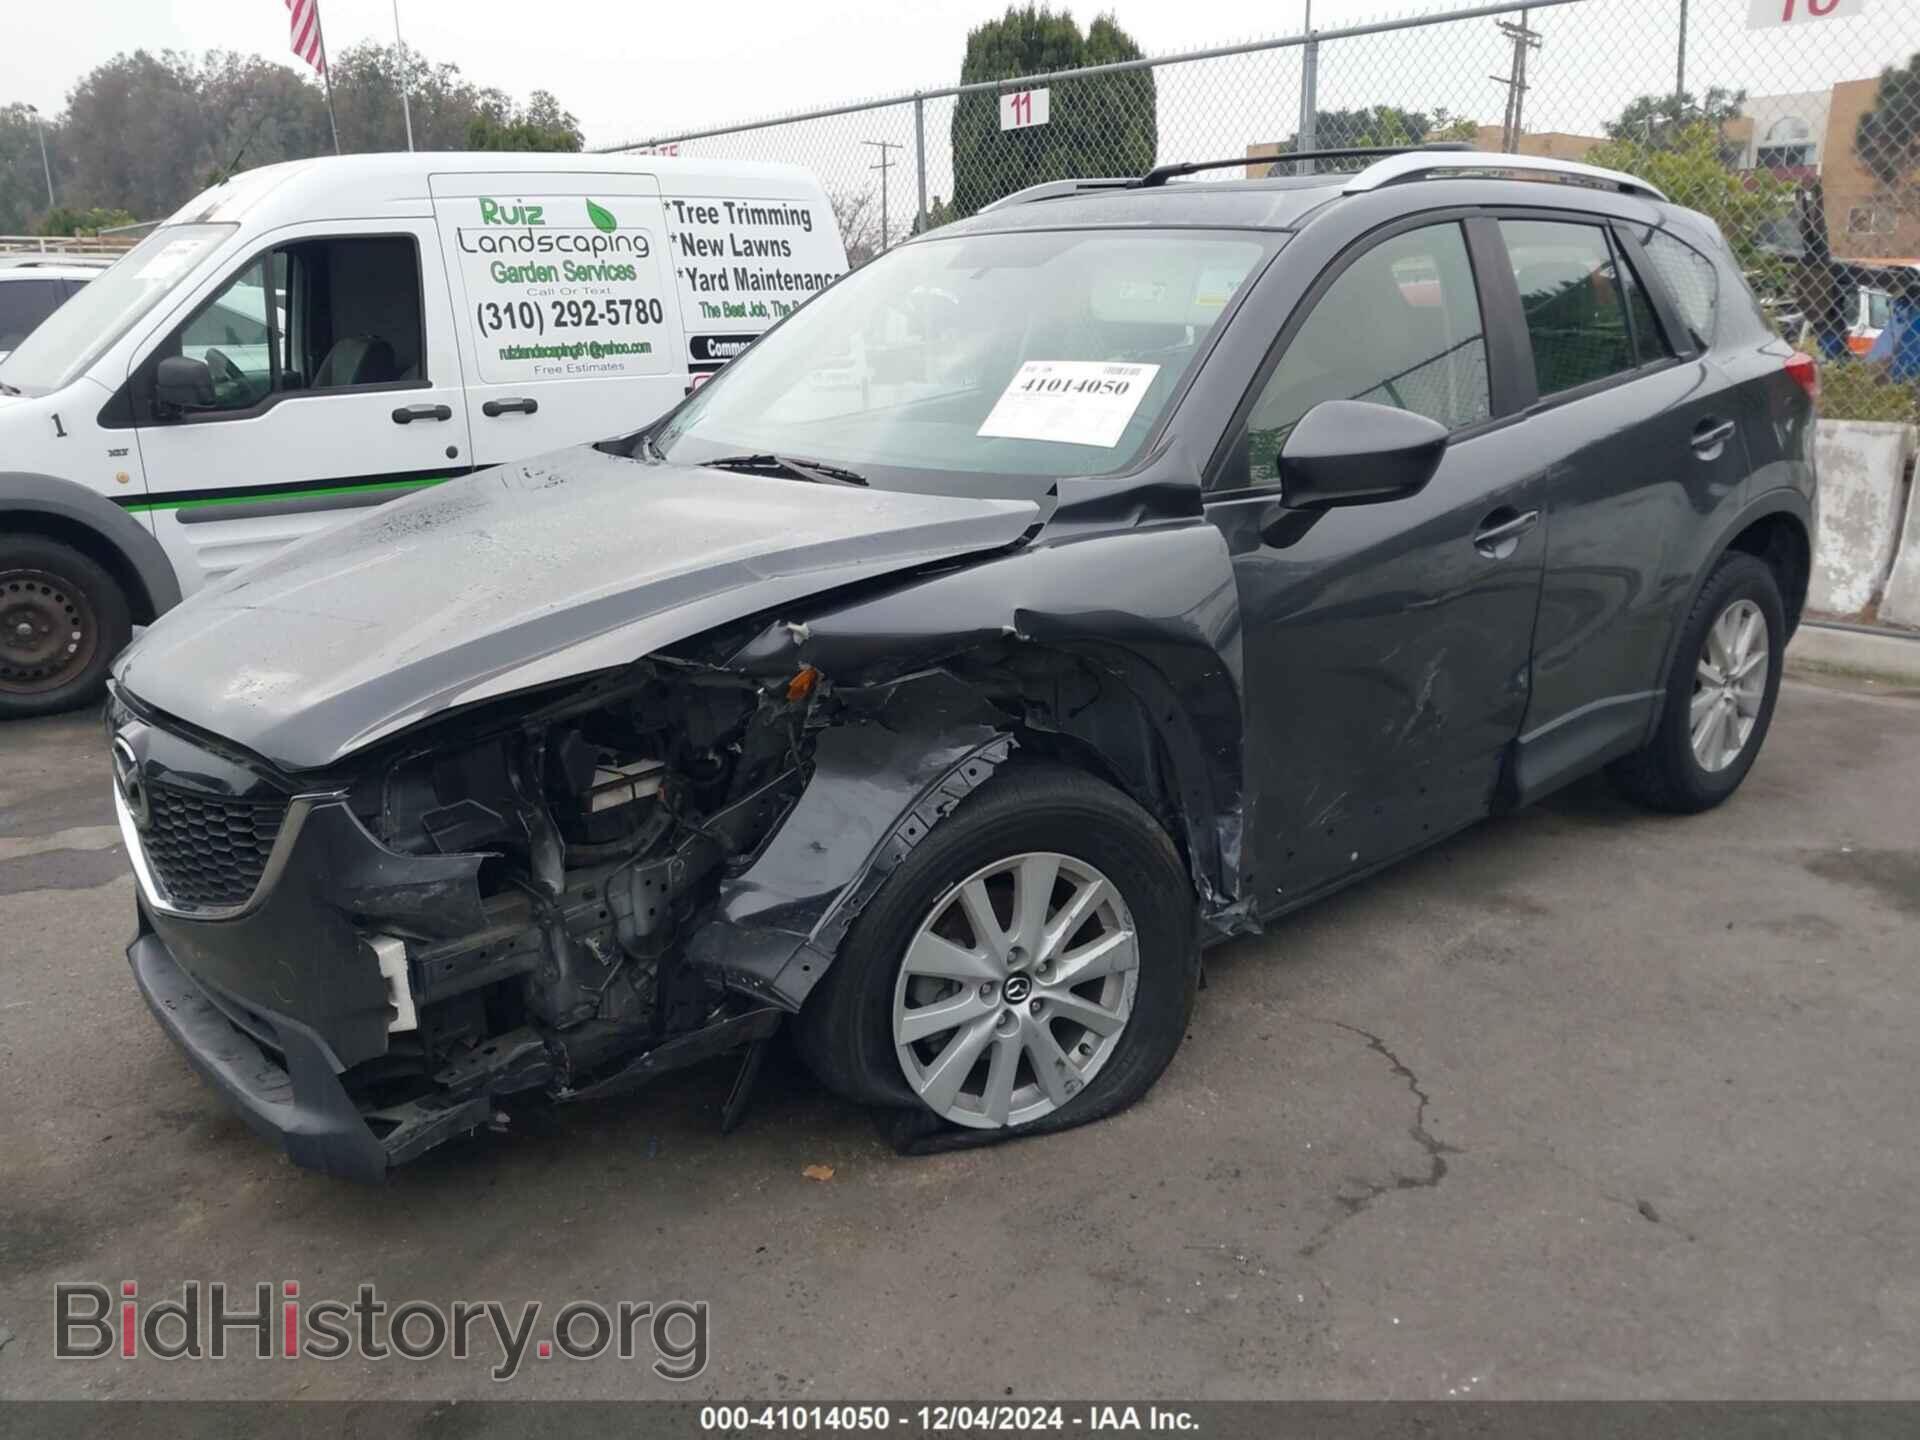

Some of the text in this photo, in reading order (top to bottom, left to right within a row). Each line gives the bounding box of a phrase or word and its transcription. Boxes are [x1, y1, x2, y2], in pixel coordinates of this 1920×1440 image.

[1010, 92, 1031, 126] 11
[479, 197, 546, 225] Ruiz
[723, 201, 812, 232] Trimming
[457, 227, 650, 258] Landscaping
[729, 233, 791, 257] Lawns
[490, 259, 637, 284] Garden Services
[526, 285, 612, 297] Call Or Text
[477, 298, 664, 338] (310) 292-5780
[699, 301, 720, 319] The
[722, 300, 747, 318] Best
[749, 299, 770, 320] Job,
[707, 338, 750, 357] Comme
[534, 361, 625, 375] Free Estimates
[1020, 378, 1130, 396] 41014050
[51, 413, 68, 438] 1
